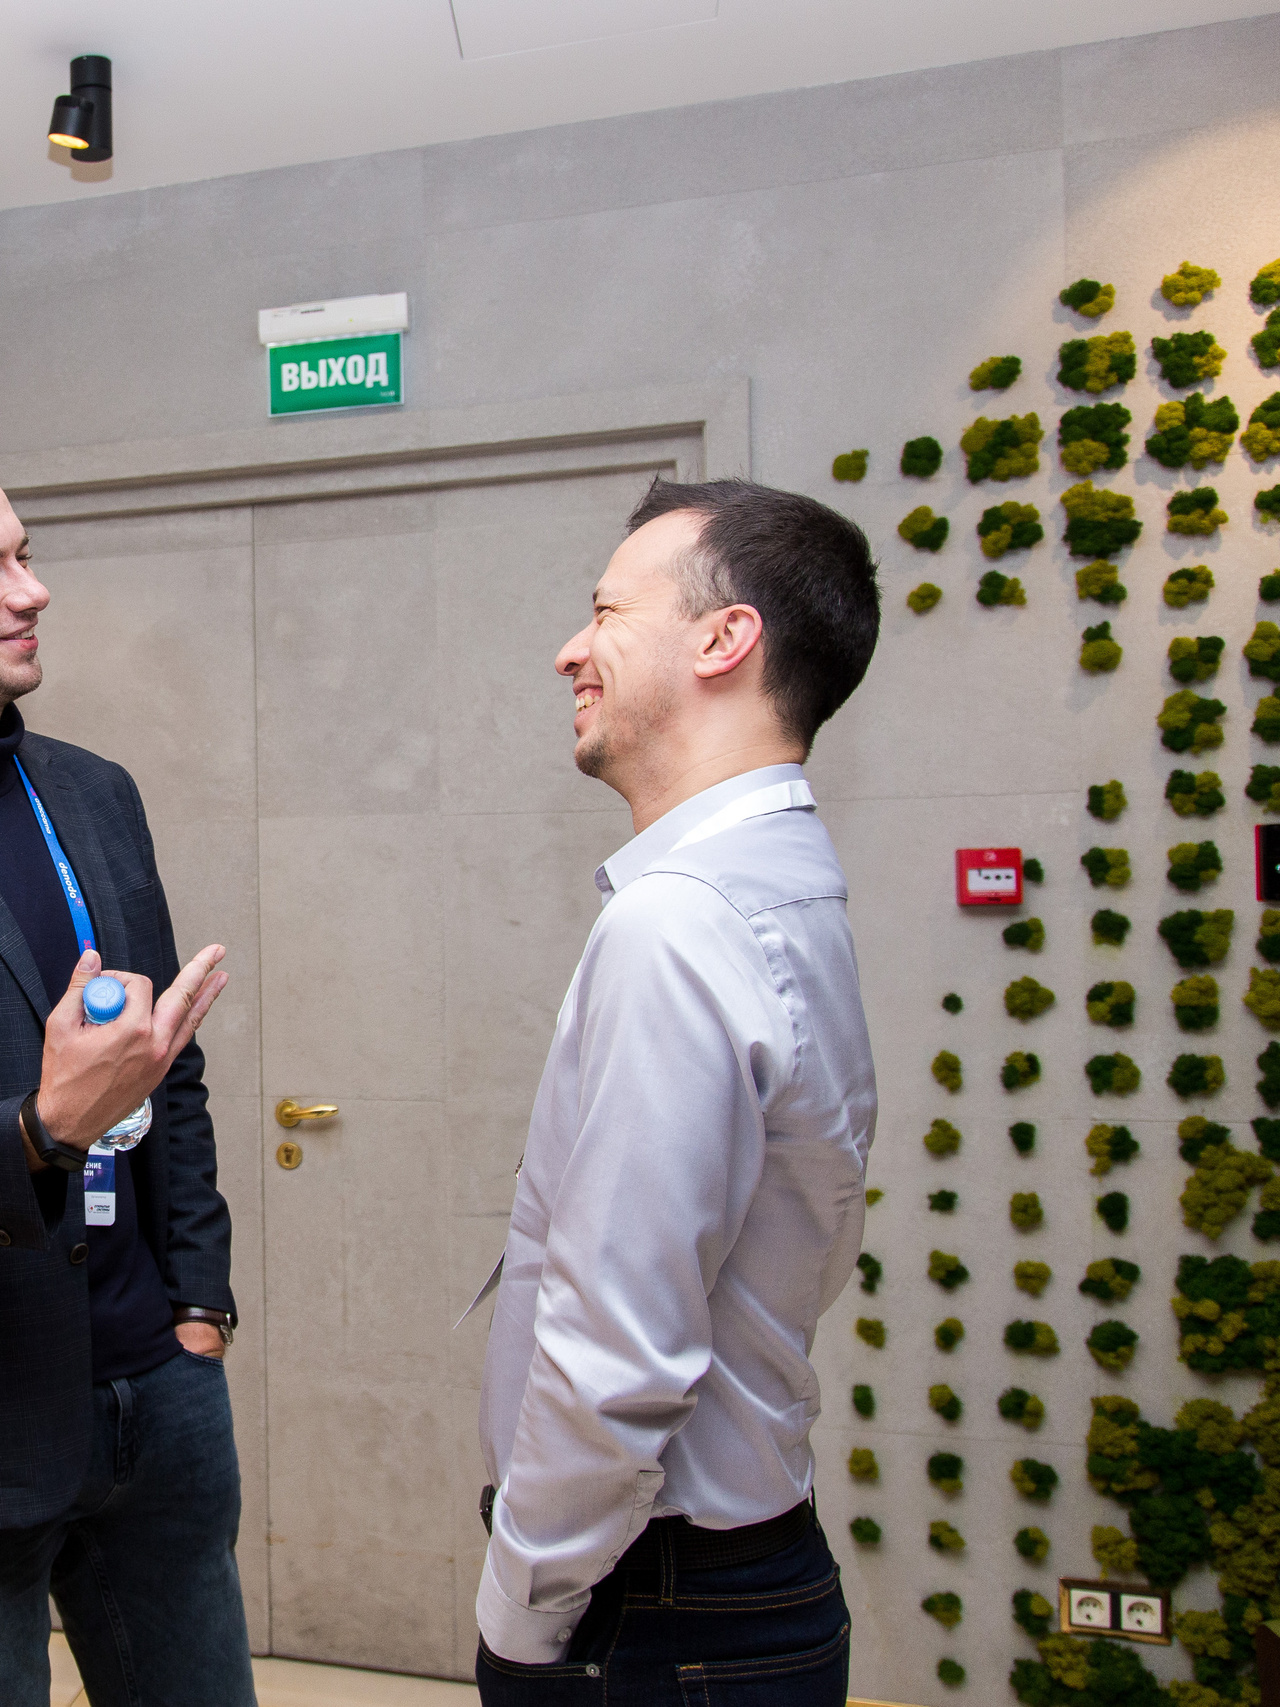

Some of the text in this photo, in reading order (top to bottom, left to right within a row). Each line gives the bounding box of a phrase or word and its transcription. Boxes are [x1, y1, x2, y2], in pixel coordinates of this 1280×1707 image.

[281, 352, 389, 392] ВЫХОД
[34, 797, 52, 835] ataccama
[58, 862, 77, 899] denodo
